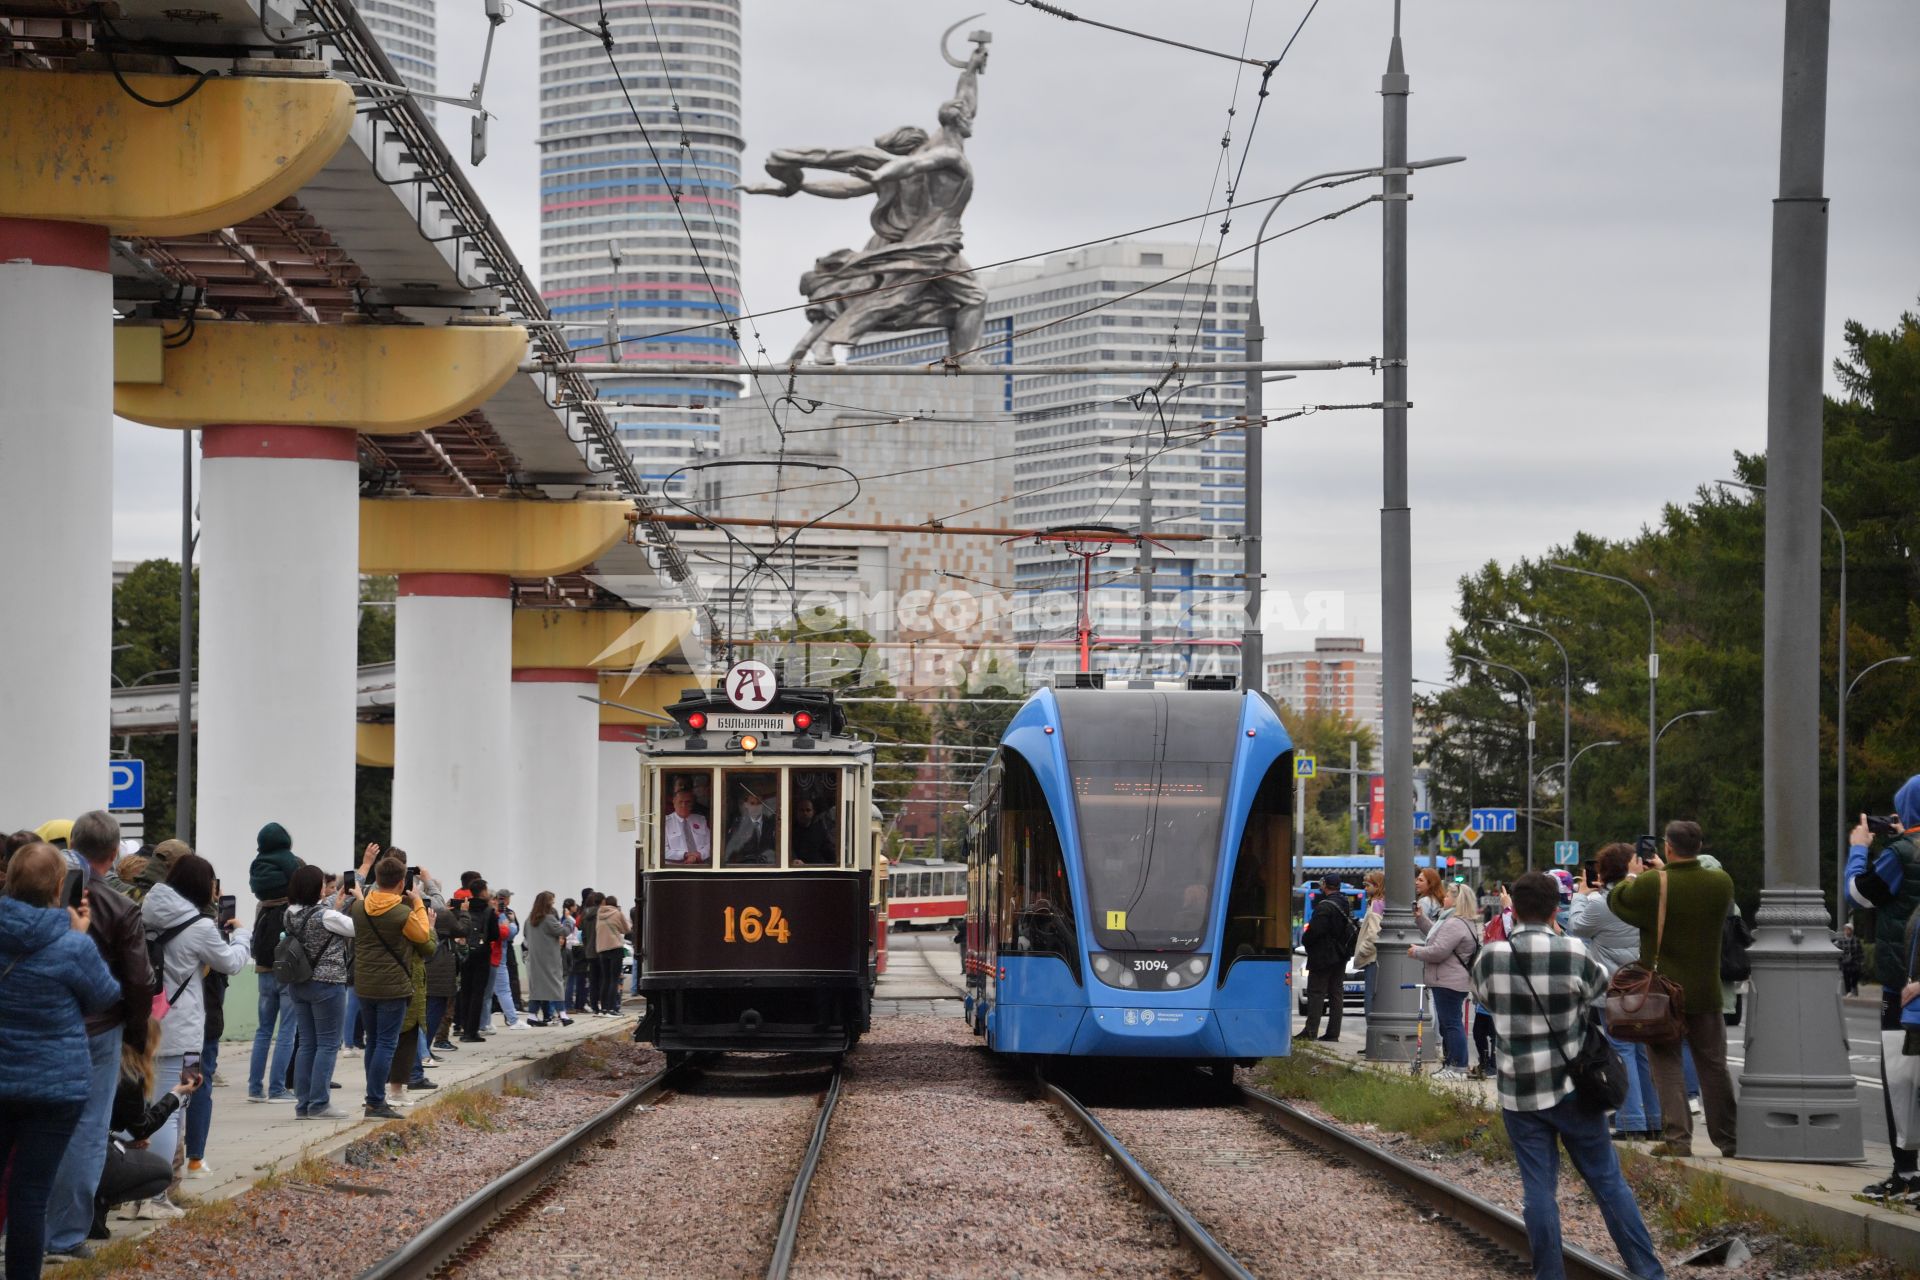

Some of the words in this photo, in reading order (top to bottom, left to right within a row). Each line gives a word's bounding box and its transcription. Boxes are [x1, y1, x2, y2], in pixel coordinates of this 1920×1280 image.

[717, 718, 784, 729] БУЛЬВАРНАЯ
[108, 765, 134, 804] P
[723, 906, 791, 943] 164
[1133, 960, 1168, 971] 31094
